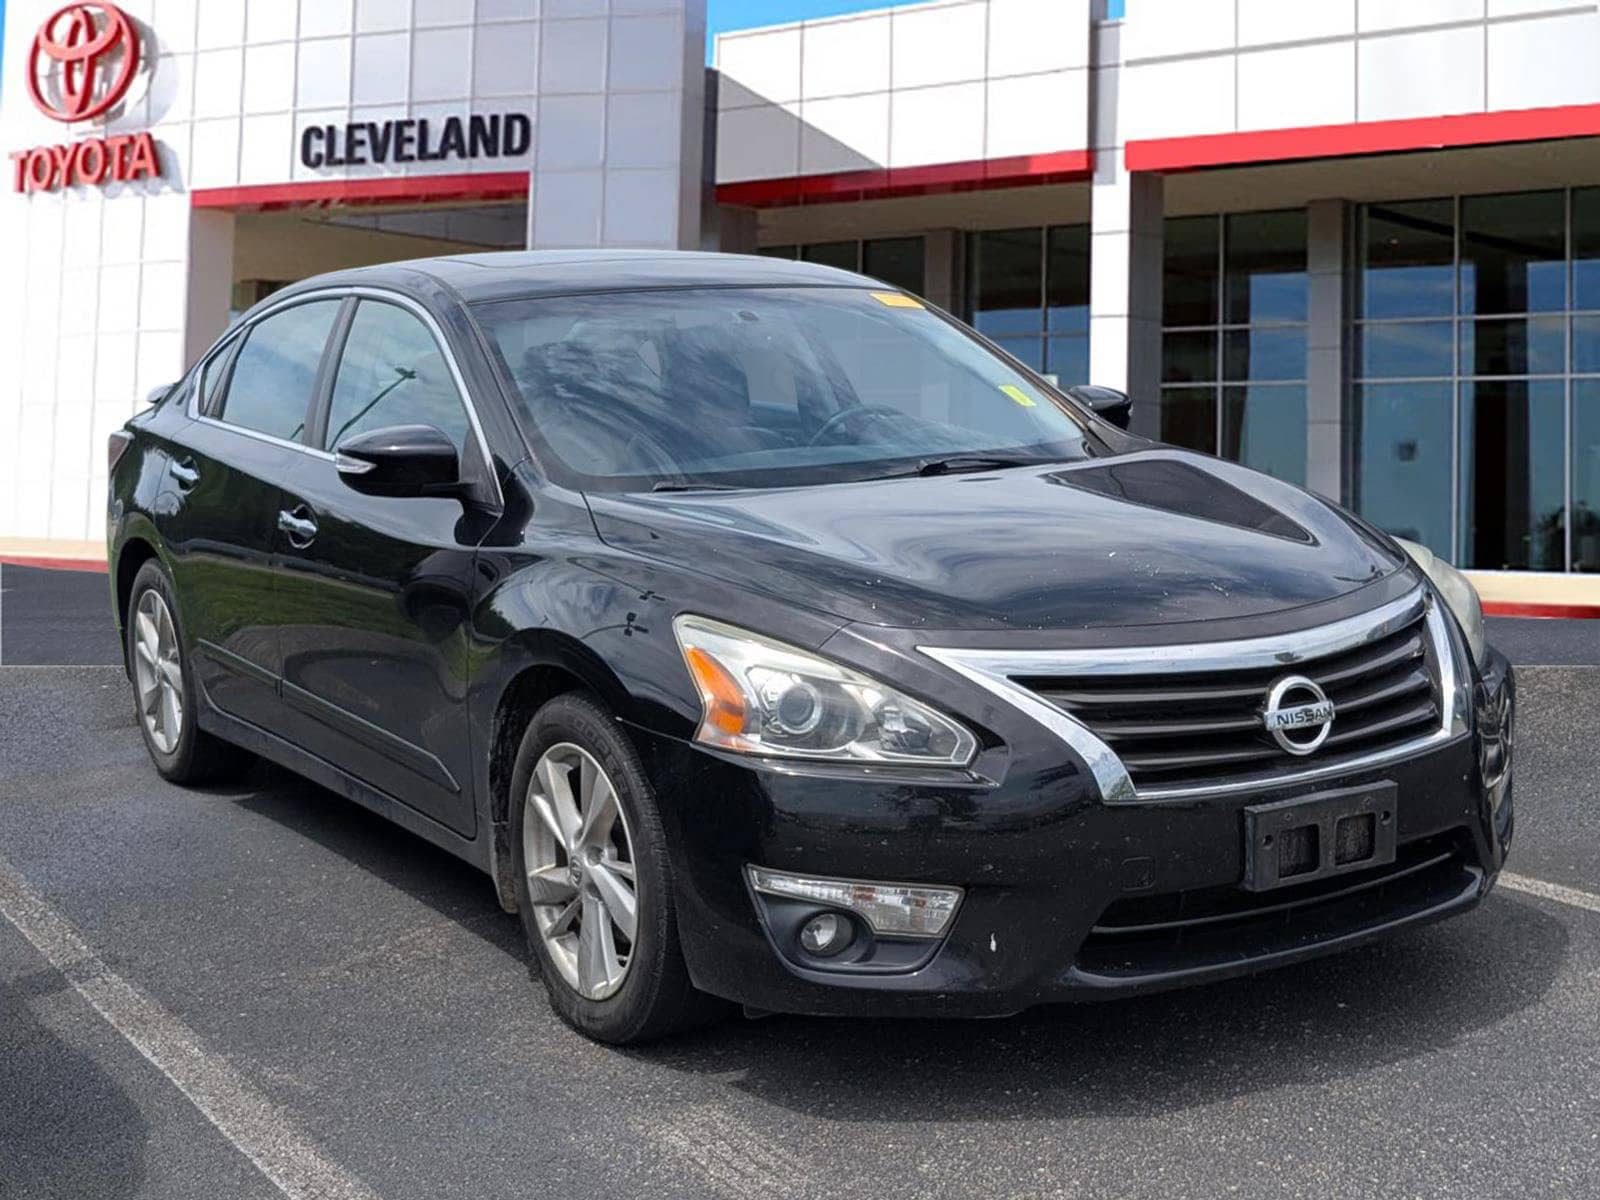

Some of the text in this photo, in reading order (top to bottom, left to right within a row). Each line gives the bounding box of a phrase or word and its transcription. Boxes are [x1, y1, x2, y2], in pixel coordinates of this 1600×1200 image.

[9, 132, 160, 193] TOYOTA
[301, 113, 531, 169] CLEVELAND
[1276, 706, 1333, 726] NISSAN
